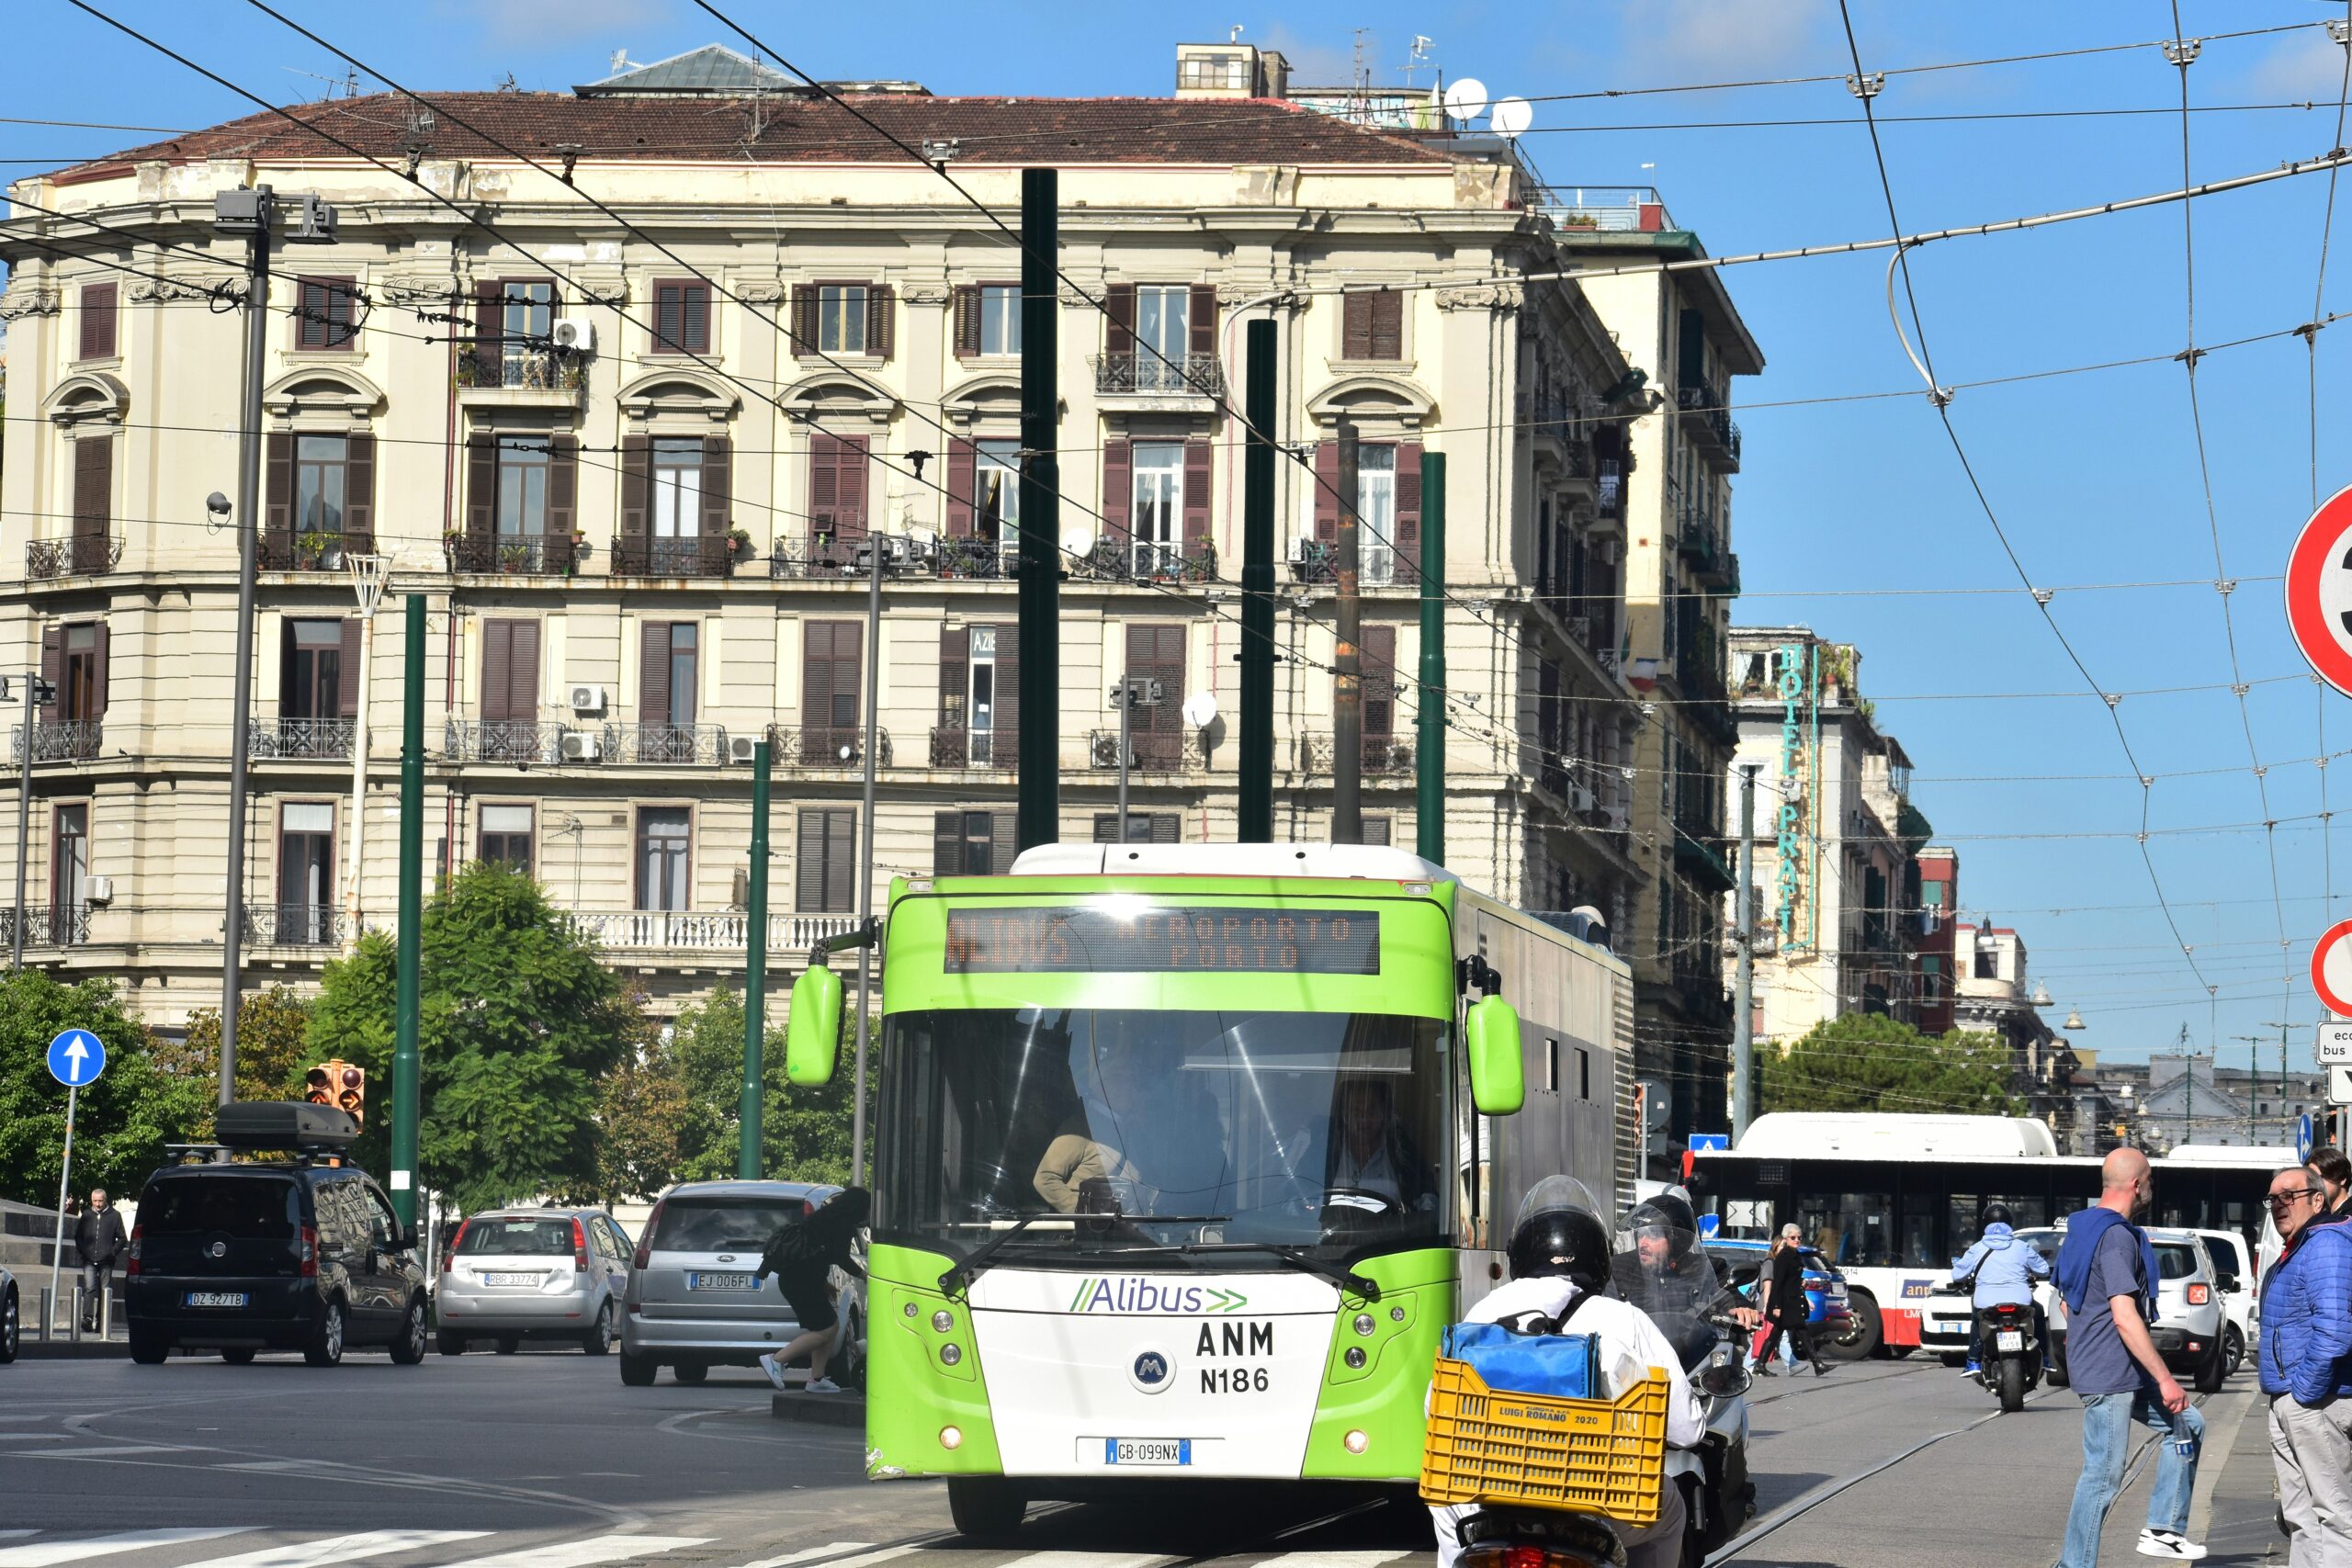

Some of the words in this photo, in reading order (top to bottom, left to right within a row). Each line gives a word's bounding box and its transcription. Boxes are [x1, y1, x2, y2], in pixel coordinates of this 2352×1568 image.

[1779, 644, 1804, 777] HOTEL
[1778, 805, 1800, 935] PRATI
[947, 918, 1069, 963] ALIBUS
[1170, 944, 1298, 968] PORTO
[2324, 1044, 2346, 1055] bus
[490, 1274, 507, 1284] RBR
[509, 1274, 537, 1284] 33774
[698, 1275, 713, 1287] EJ
[716, 1275, 752, 1288] 006FL
[193, 1293, 206, 1305] DZ
[209, 1293, 243, 1305] 927TB
[1087, 1278, 1203, 1313] Alibus
[1196, 1321, 1273, 1357] ANM
[1201, 1368, 1270, 1394] N186
[1499, 1406, 1523, 1418] LUIGI
[1526, 1410, 1566, 1423] ROMANO
[1575, 1416, 1599, 1425] 2020
